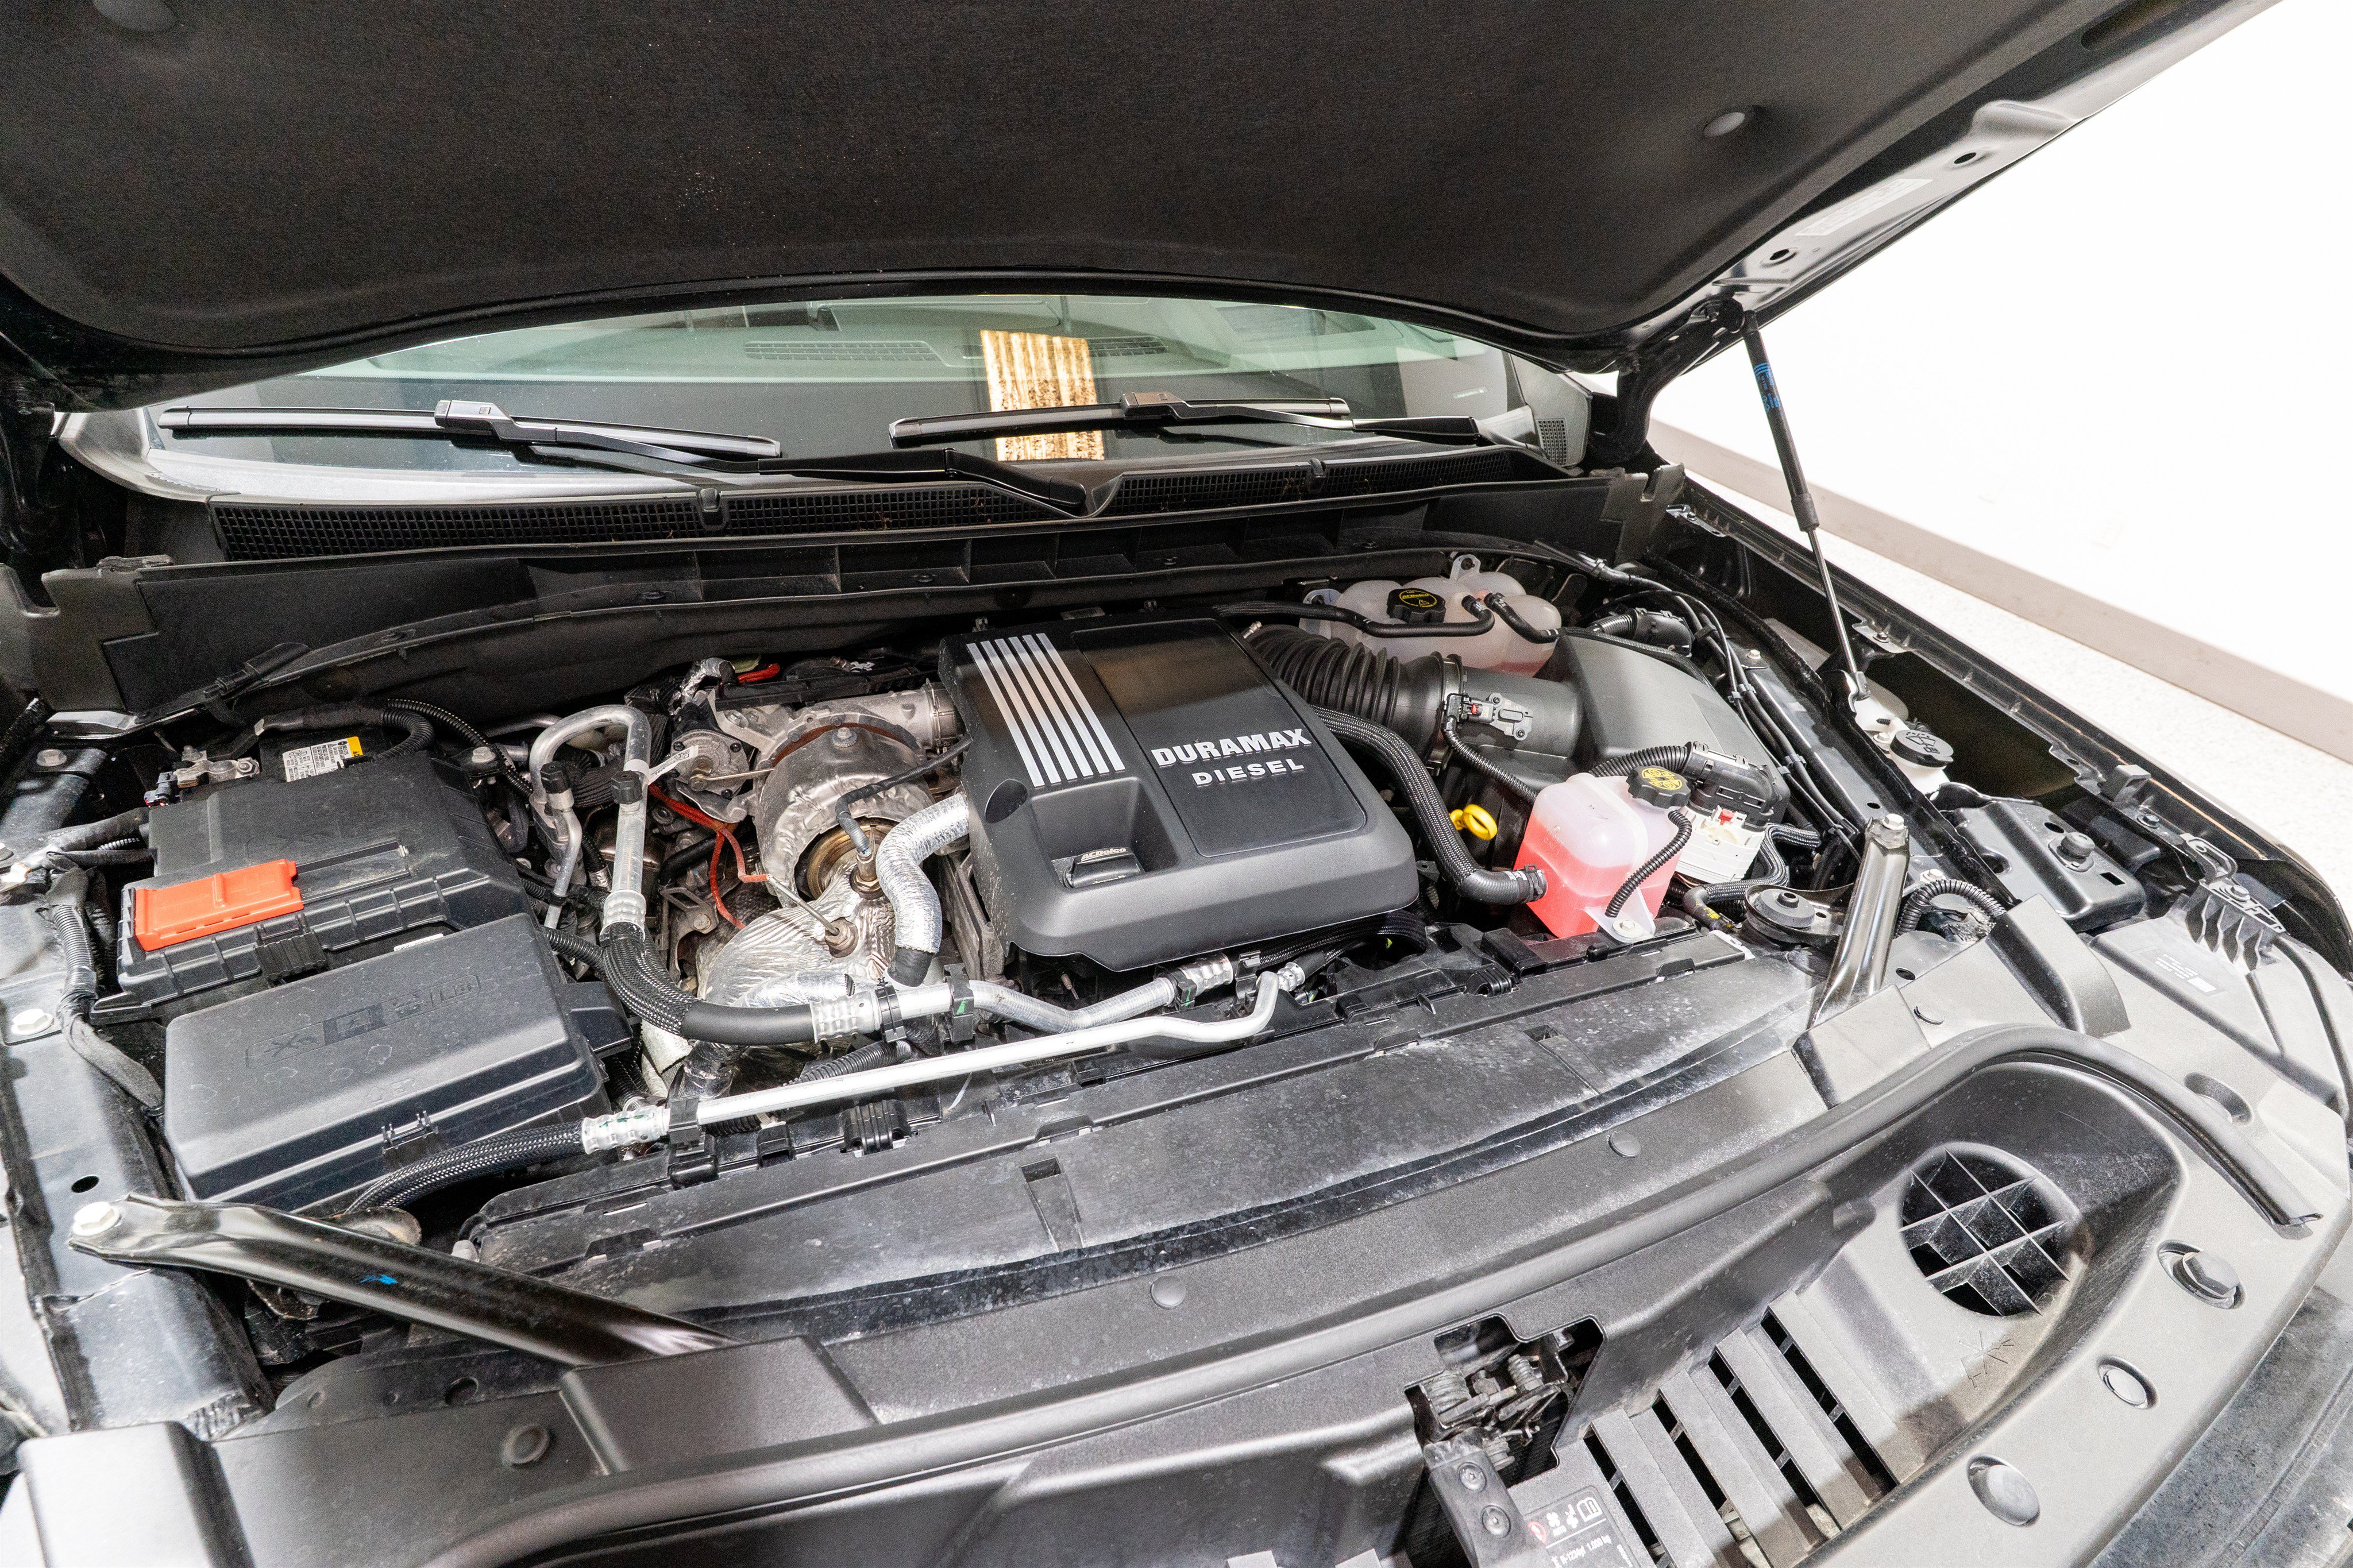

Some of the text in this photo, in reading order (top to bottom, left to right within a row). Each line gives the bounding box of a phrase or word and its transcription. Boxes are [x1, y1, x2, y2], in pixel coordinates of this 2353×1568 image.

[1151, 728, 1312, 767] DURAMAX
[1191, 758, 1304, 787] DIESEL
[1081, 848, 1127, 862] ACDelco
